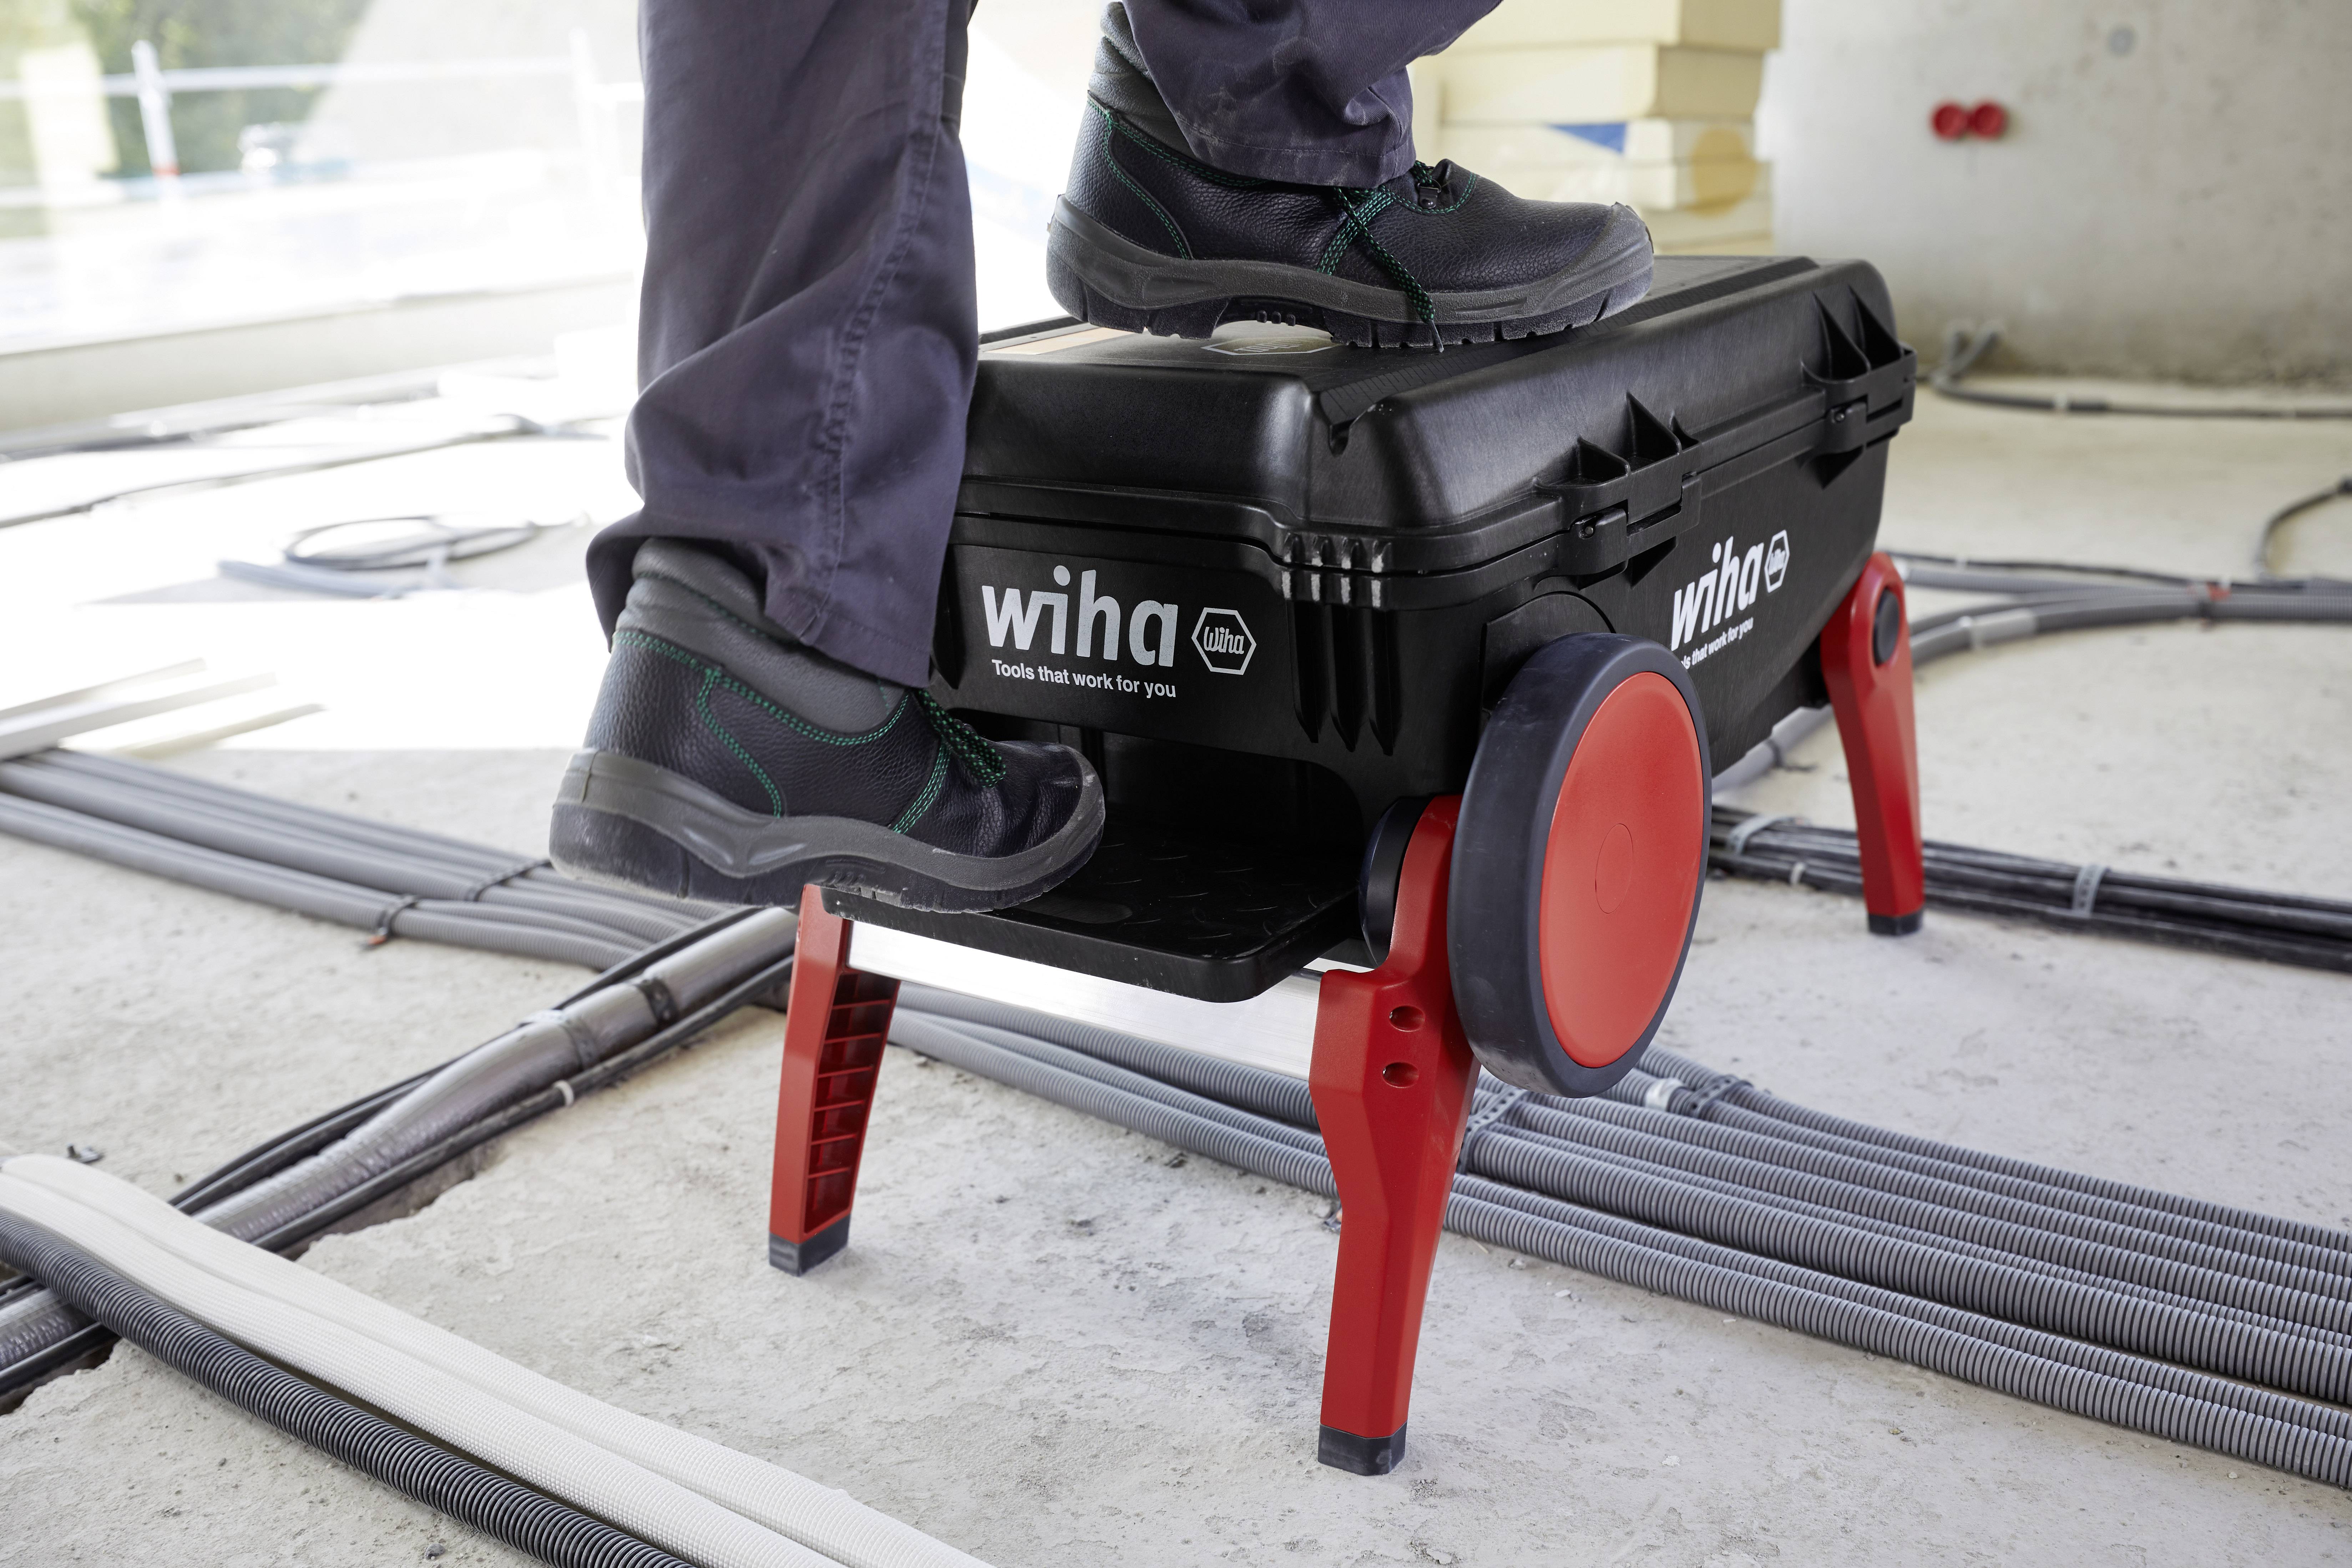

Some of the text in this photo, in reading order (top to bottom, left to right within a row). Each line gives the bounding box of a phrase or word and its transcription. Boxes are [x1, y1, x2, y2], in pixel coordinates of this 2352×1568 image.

[981, 565, 1178, 667] wiha
[1671, 536, 1764, 651] wiha
[1204, 626, 1244, 654] Wiha
[1691, 643, 1708, 666] that
[1708, 631, 1728, 655] work
[1728, 627, 1739, 643] for
[1739, 617, 1754, 640] you
[991, 659, 1176, 698] Tools that work for you
